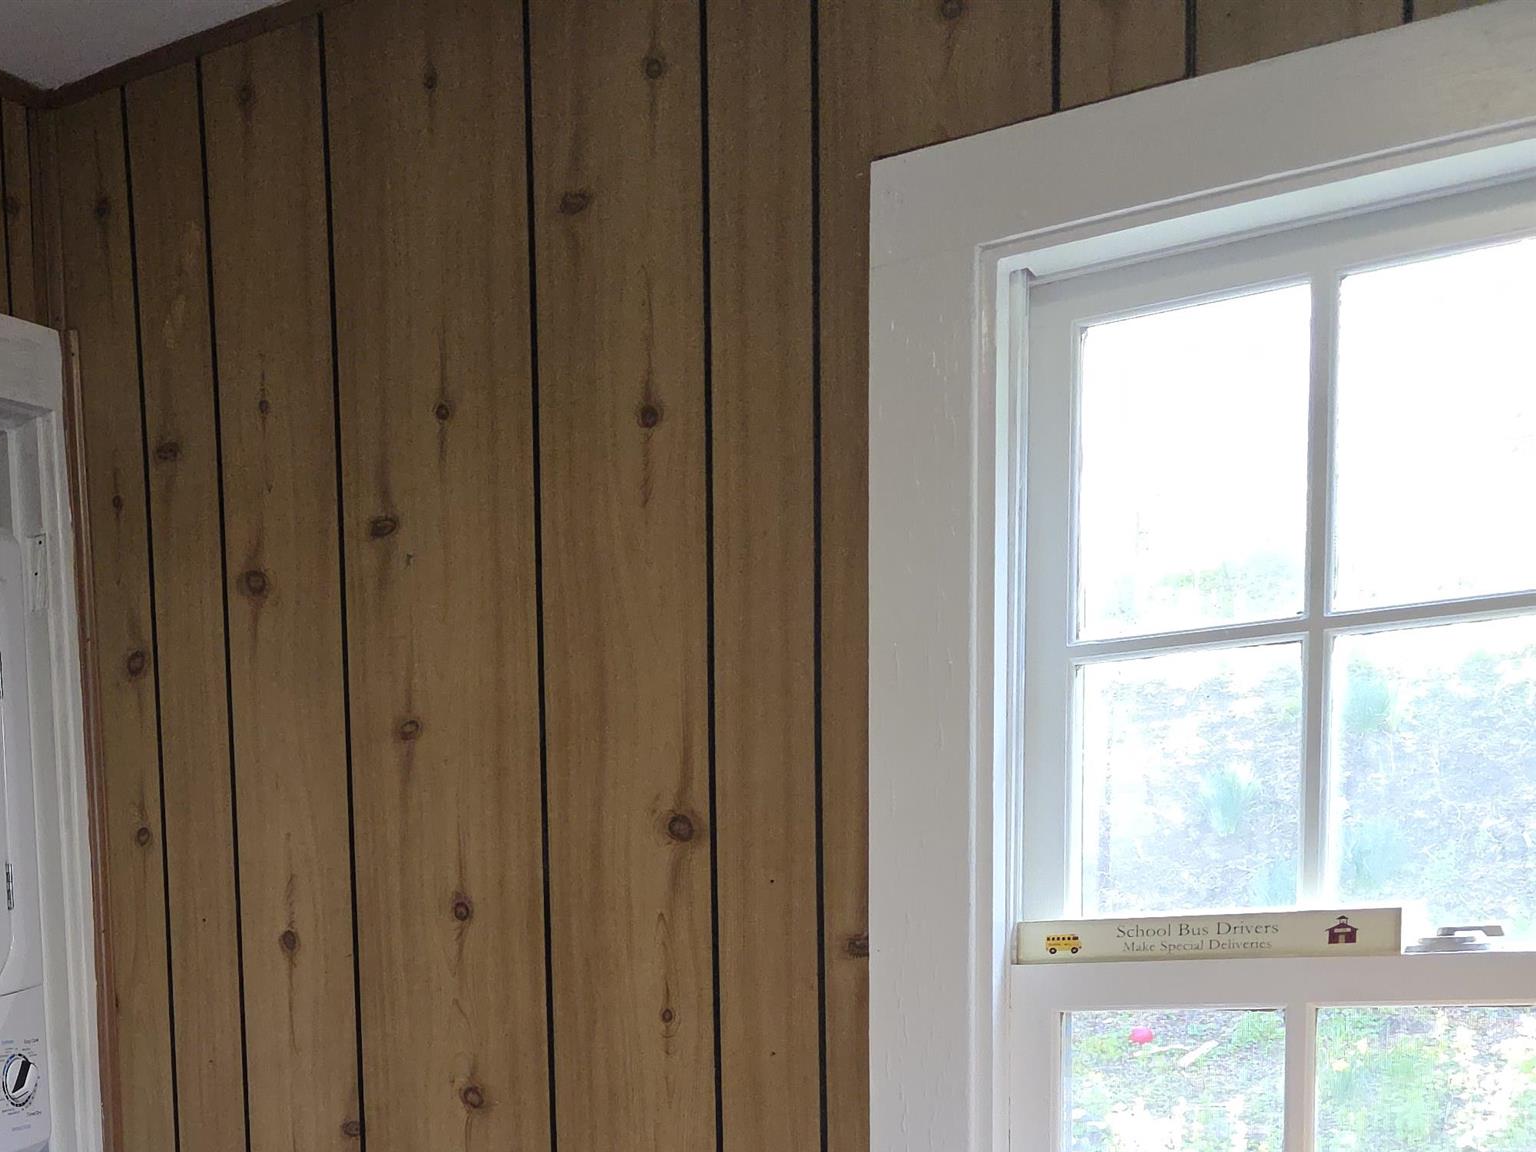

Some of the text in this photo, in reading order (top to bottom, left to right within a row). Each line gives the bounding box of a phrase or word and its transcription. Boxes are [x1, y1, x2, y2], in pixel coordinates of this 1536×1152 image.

[1116, 920, 1280, 938] School Bus Drivers
[1122, 939, 1272, 953] Make Special Deliveries
